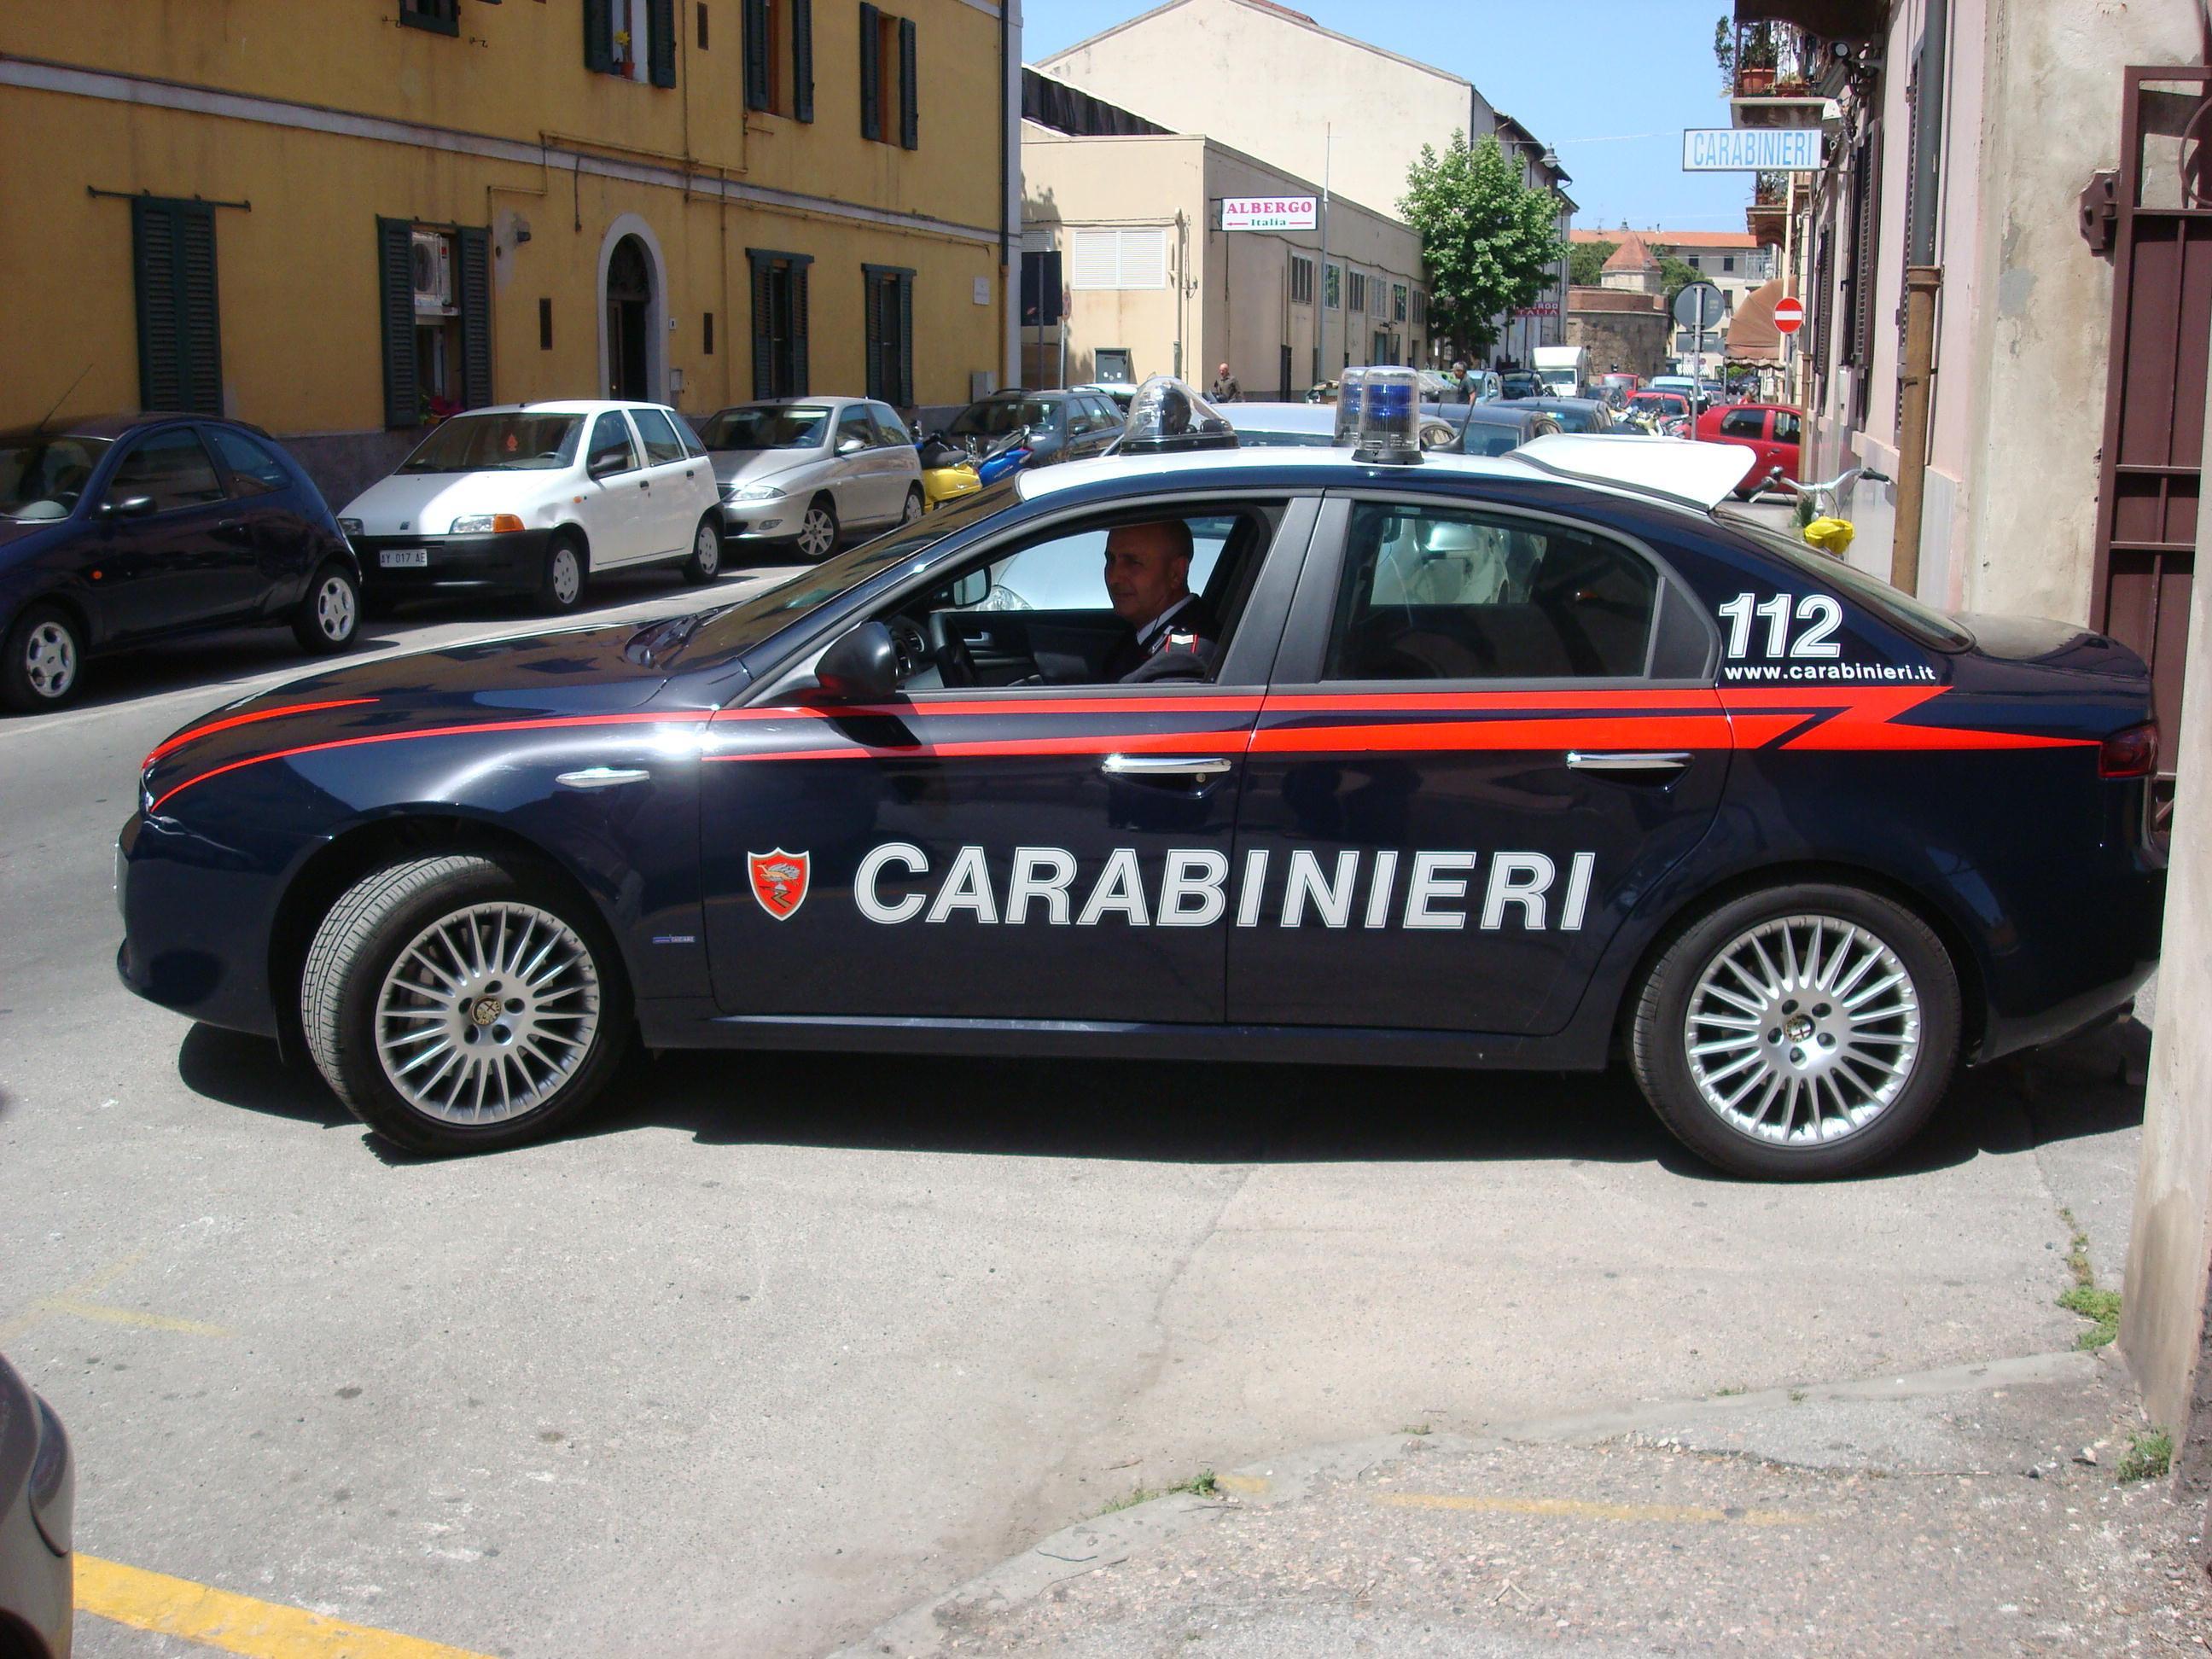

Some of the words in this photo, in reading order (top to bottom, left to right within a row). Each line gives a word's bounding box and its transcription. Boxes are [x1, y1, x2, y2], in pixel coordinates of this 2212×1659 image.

[1693, 131, 1813, 166] CARABINIERI
[1226, 201, 1313, 214] ALBERGO
[1250, 218, 1287, 227] Italia
[395, 553, 410, 563] 017
[1718, 592, 1843, 659] 112
[1724, 662, 1936, 681] www.carabinieri.it
[853, 841, 1596, 930] CARABINIERI
